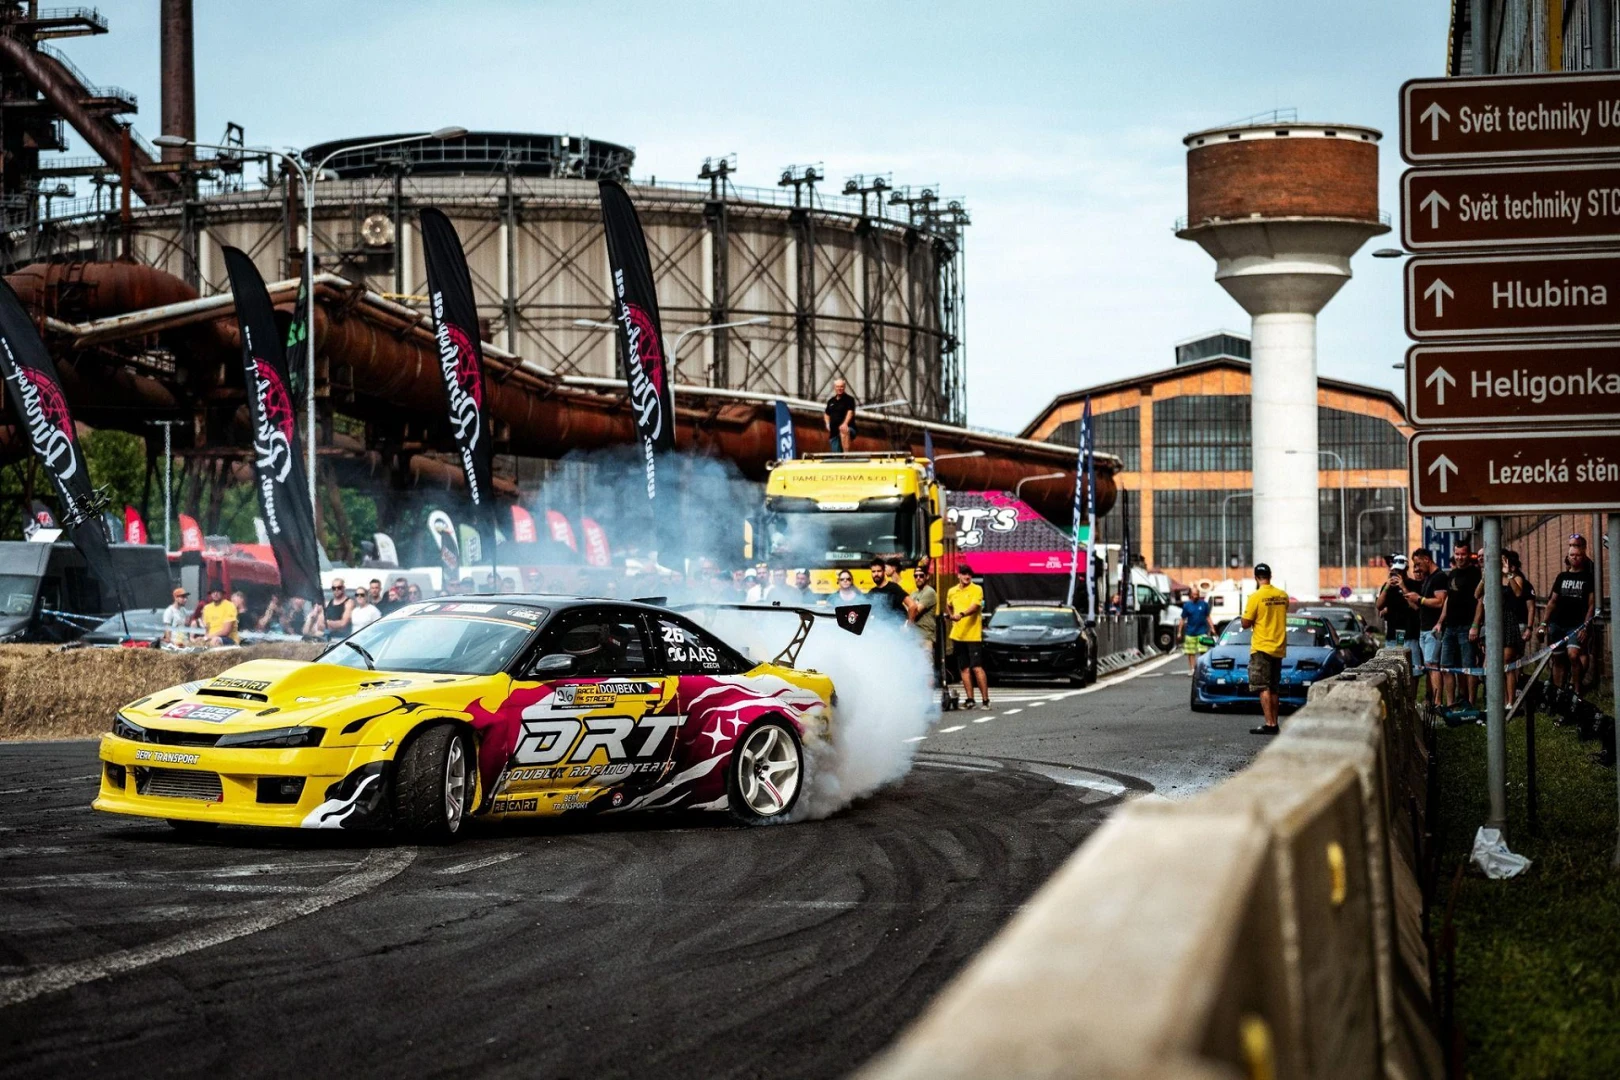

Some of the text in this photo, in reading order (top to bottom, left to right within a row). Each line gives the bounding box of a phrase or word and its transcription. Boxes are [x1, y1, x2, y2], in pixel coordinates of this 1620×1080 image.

[1459, 100, 1620, 136] Svět techniky U6
[1459, 188, 1620, 225] Svět techniky STC
[1492, 279, 1608, 309] Hlubina
[1471, 367, 1620, 404] Heligonka
[1488, 457, 1619, 485] Lezecká stěn
[1561, 580, 1584, 590] REPLAY
[661, 627, 685, 643] 26
[557, 689, 574, 702] 26
[600, 683, 635, 694] DOUBEK
[637, 683, 645, 693] V.
[585, 695, 615, 703] STREETS
[515, 715, 688, 763] DRT
[154, 751, 200, 765] TRANSPORT
[501, 766, 567, 782] DOUBEK
[570, 763, 629, 777] RACING
[552, 801, 589, 810] TRANSPORT
